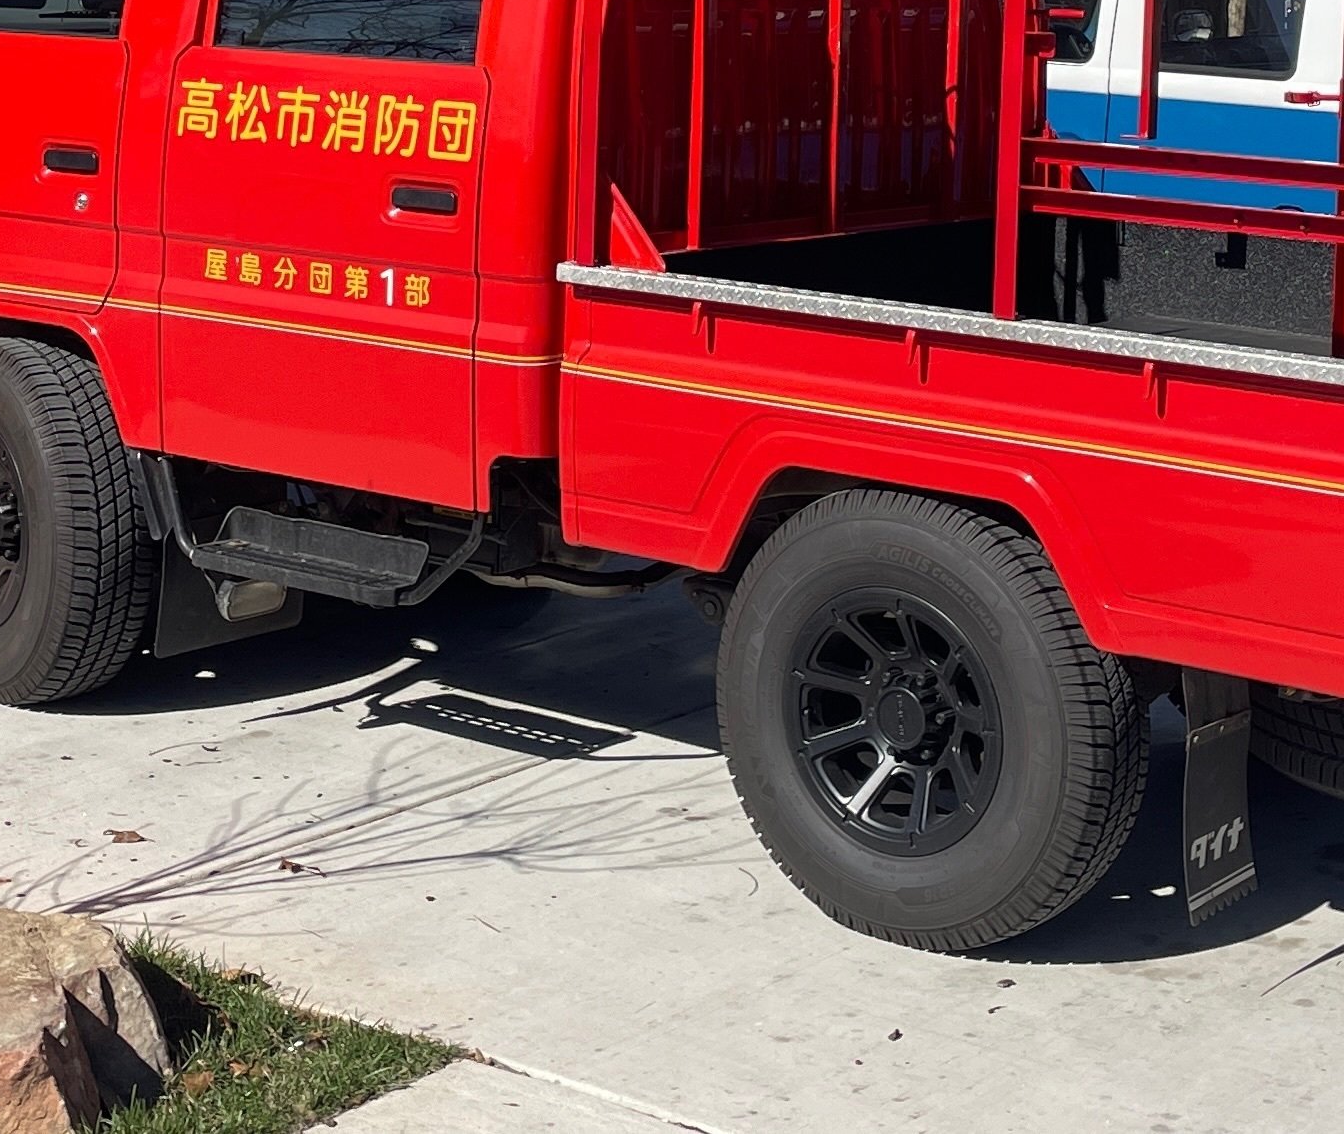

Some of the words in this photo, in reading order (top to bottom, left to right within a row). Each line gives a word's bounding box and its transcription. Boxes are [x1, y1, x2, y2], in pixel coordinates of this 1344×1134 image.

[176, 77, 478, 163] 高松市消防団
[204, 247, 432, 309] 屋島分団第1部
[1190, 816, 1245, 870] ダイナ
